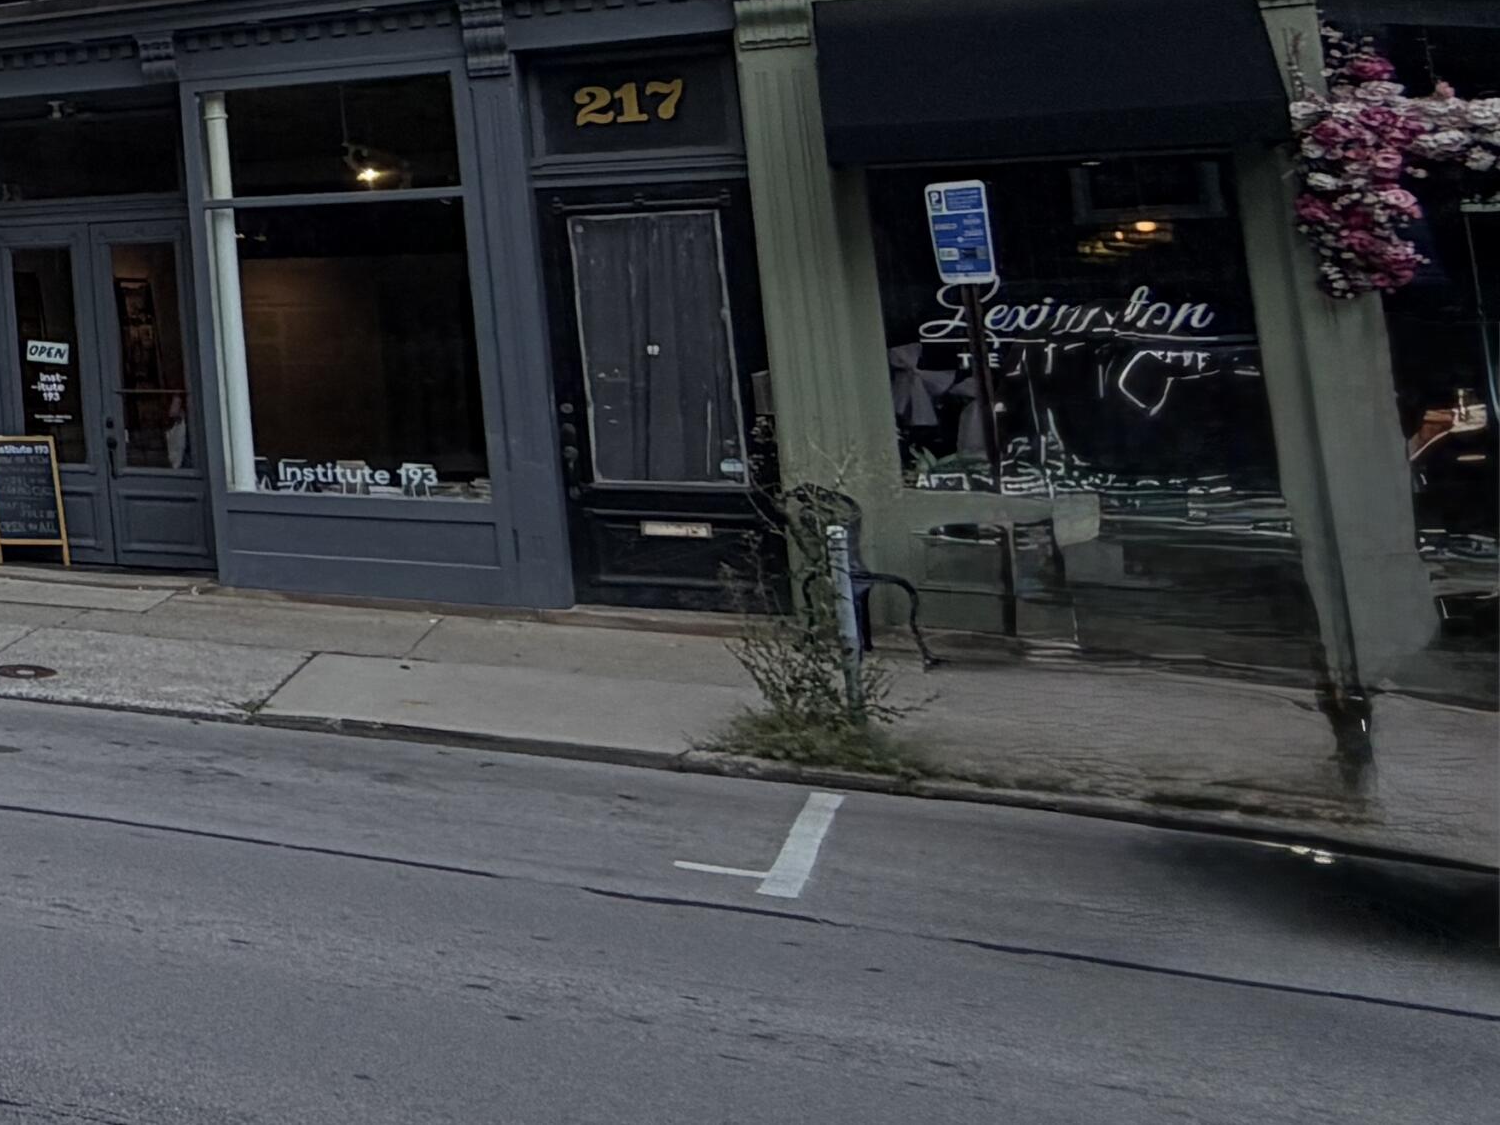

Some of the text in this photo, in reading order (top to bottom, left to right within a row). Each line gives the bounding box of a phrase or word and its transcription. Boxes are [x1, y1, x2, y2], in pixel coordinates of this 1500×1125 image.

[574, 79, 683, 125] 217
[29, 345, 66, 359] OPEN
[42, 392, 60, 401] 193
[34, 445, 49, 454] 193
[278, 460, 438, 486] Institute 193
